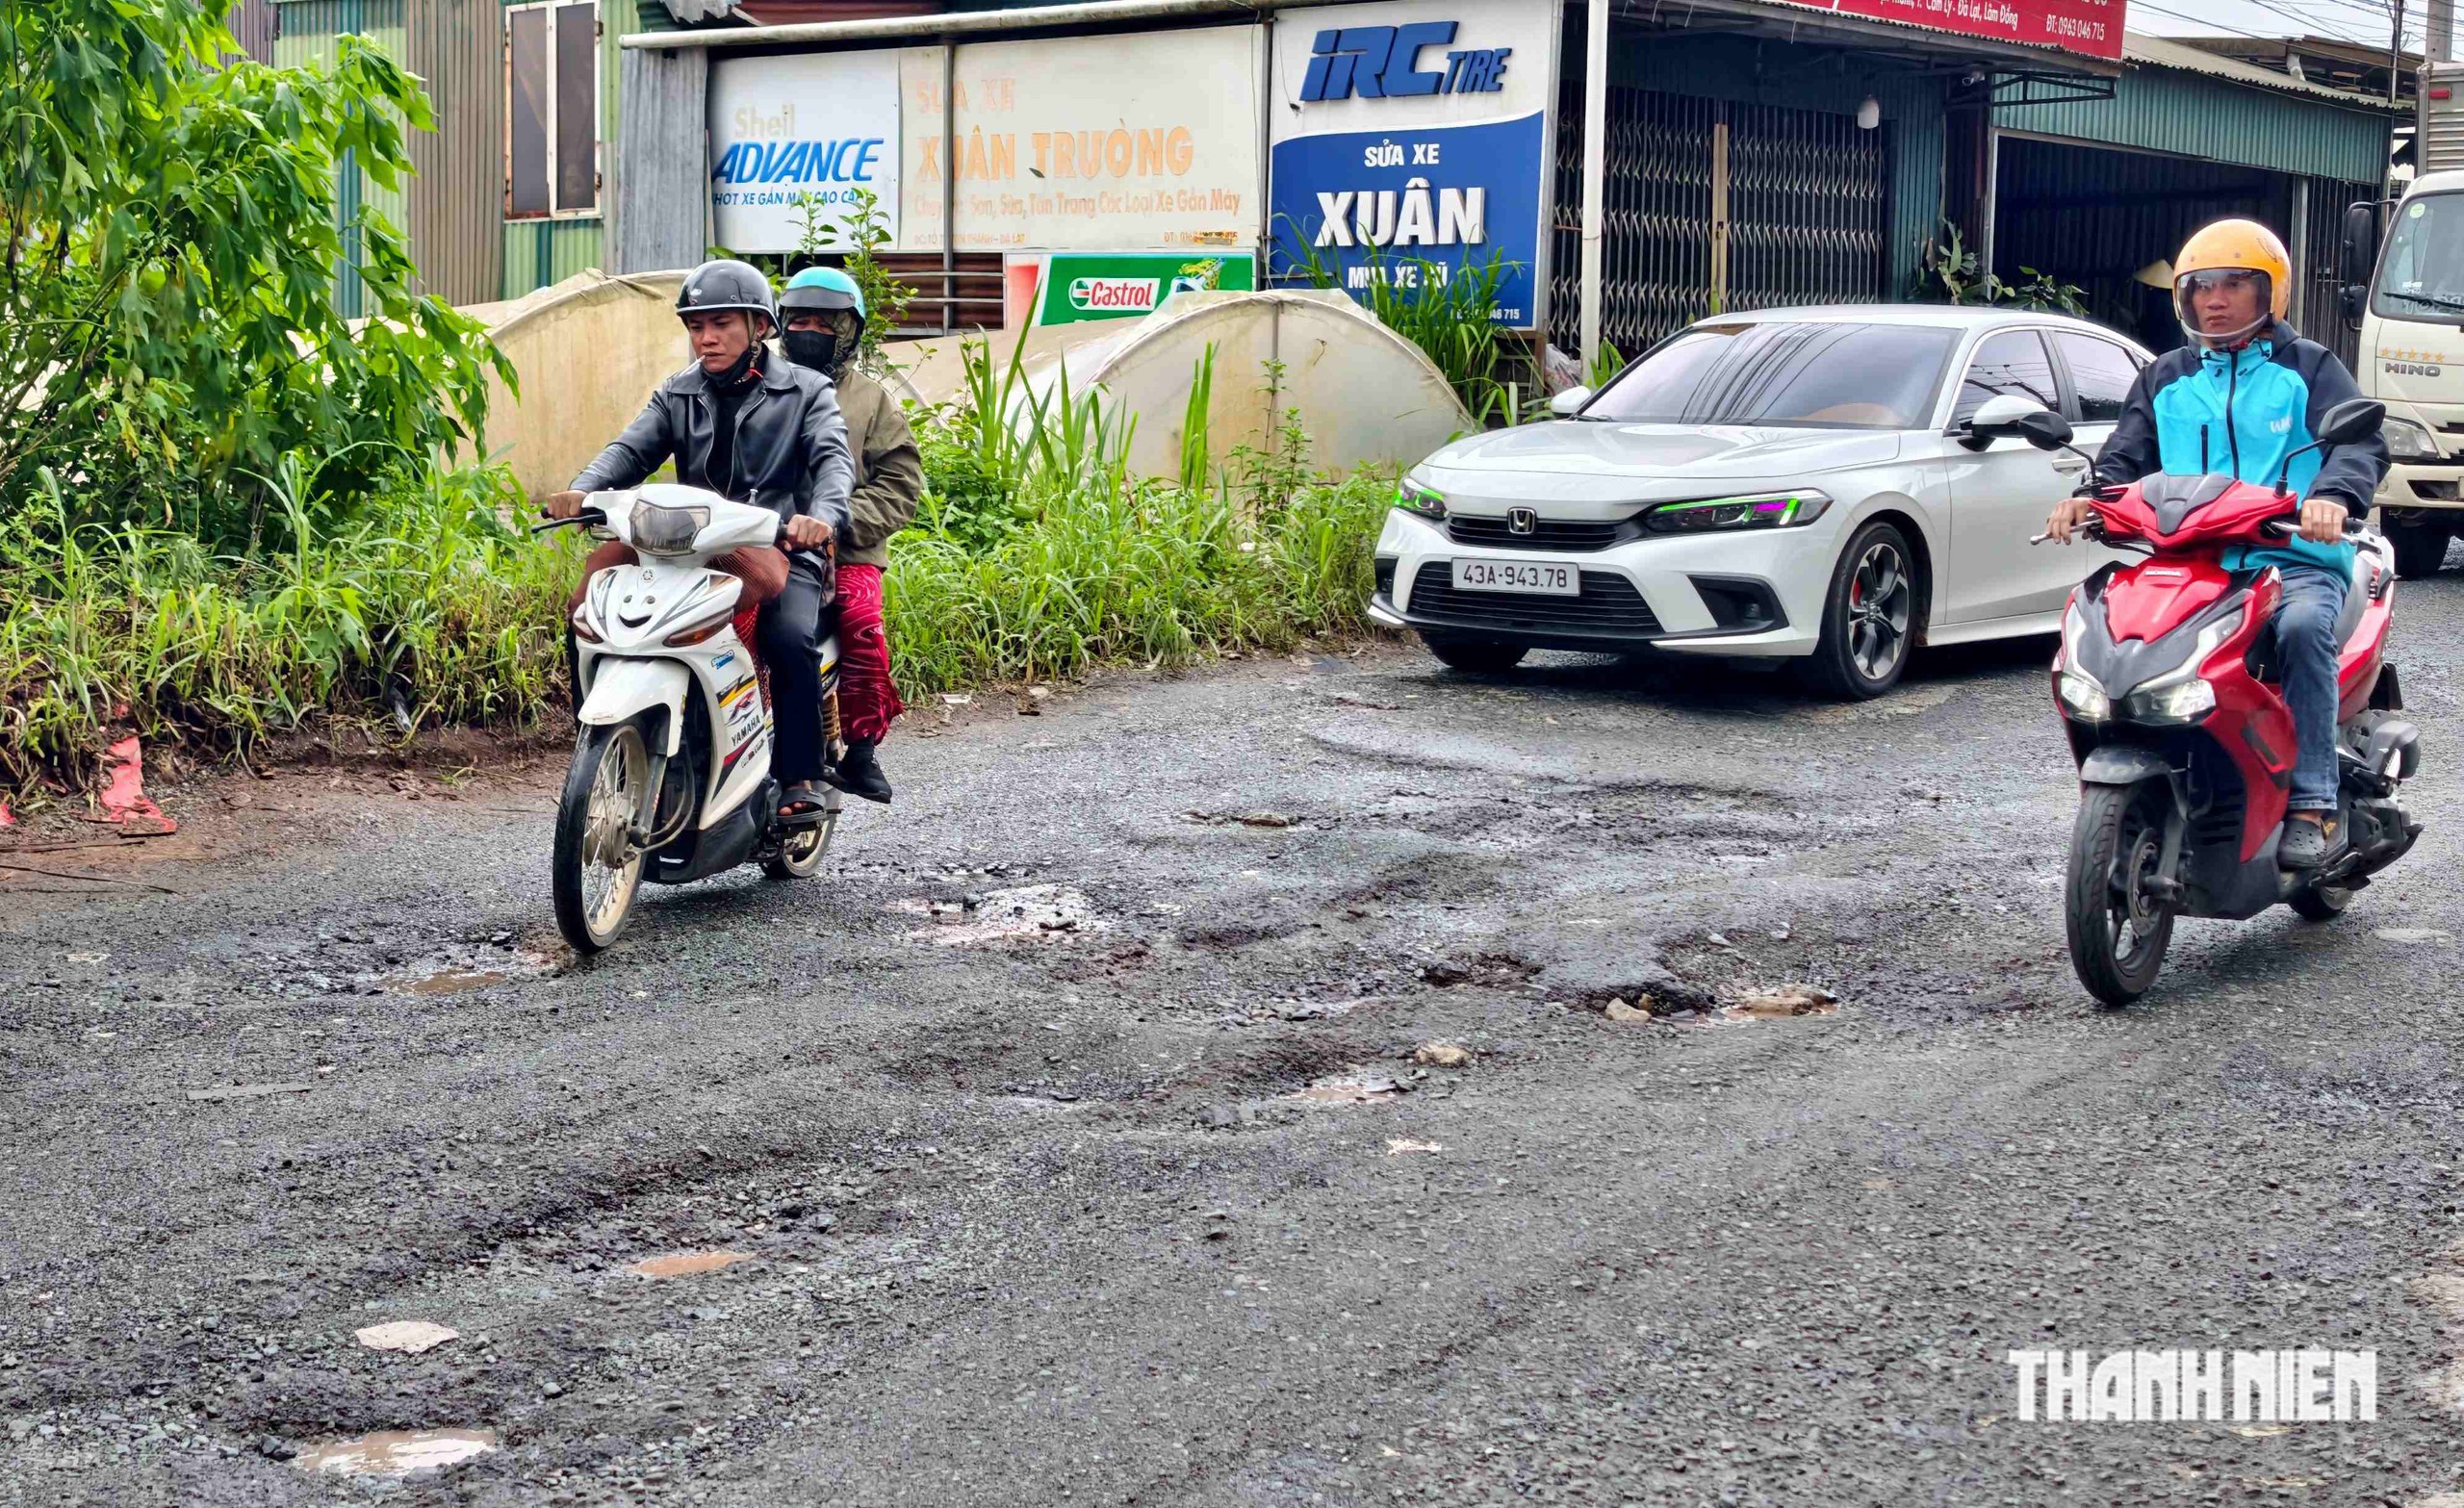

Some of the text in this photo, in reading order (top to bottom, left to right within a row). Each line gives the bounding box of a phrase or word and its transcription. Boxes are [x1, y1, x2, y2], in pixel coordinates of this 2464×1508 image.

[2045, 13, 2106, 41] ĐT: 0963 046 715
[1442, 47, 1512, 94] TIRE
[733, 102, 796, 138] Shell
[711, 138, 885, 184] ADVANCE
[1364, 138, 1440, 167] SỬA XE
[741, 192, 756, 205] XE
[1314, 177, 1485, 247] XUÂN
[1394, 265, 1418, 289] XE
[1091, 280, 1153, 307] Castrol
[1503, 308, 1521, 320] 715
[2385, 363, 2441, 377] HINO
[1463, 564, 1567, 588] 43A-943.78
[731, 714, 761, 747] YAMAHA
